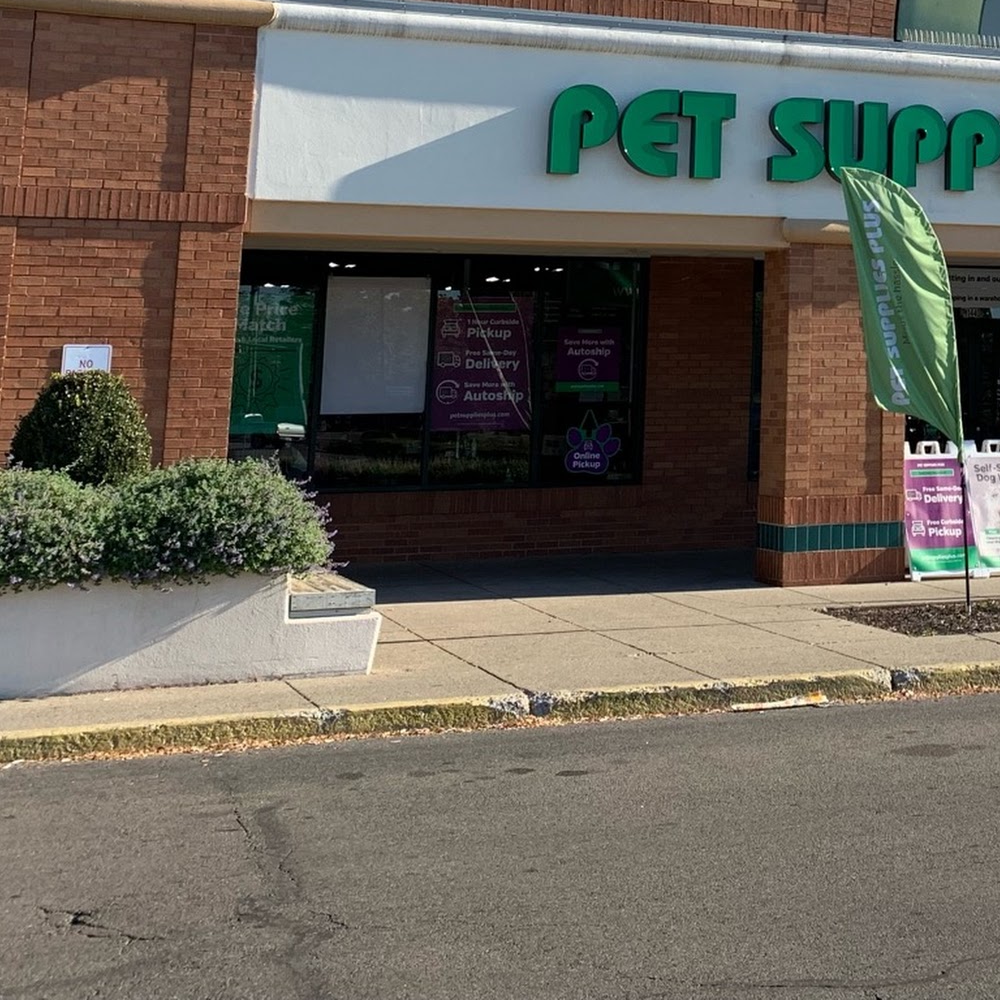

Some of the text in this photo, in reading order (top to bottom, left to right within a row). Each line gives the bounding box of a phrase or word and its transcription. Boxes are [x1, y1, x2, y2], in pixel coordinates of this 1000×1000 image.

[546, 83, 737, 179] PET
[255, 302, 299, 316] Price
[863, 200, 910, 407] PET SUPPLIES PLUS
[467, 327, 512, 340] Pickup
[567, 347, 611, 357] Autoship
[79, 359, 94, 368] NO
[465, 359, 520, 371] Delivery
[463, 390, 524, 403] Autoship
[573, 452, 600, 460] Online
[572, 460, 601, 469] Pickup
[976, 473, 996, 484] Dog
[924, 493, 963, 504] Delivery
[928, 527, 962, 538] Pickup
